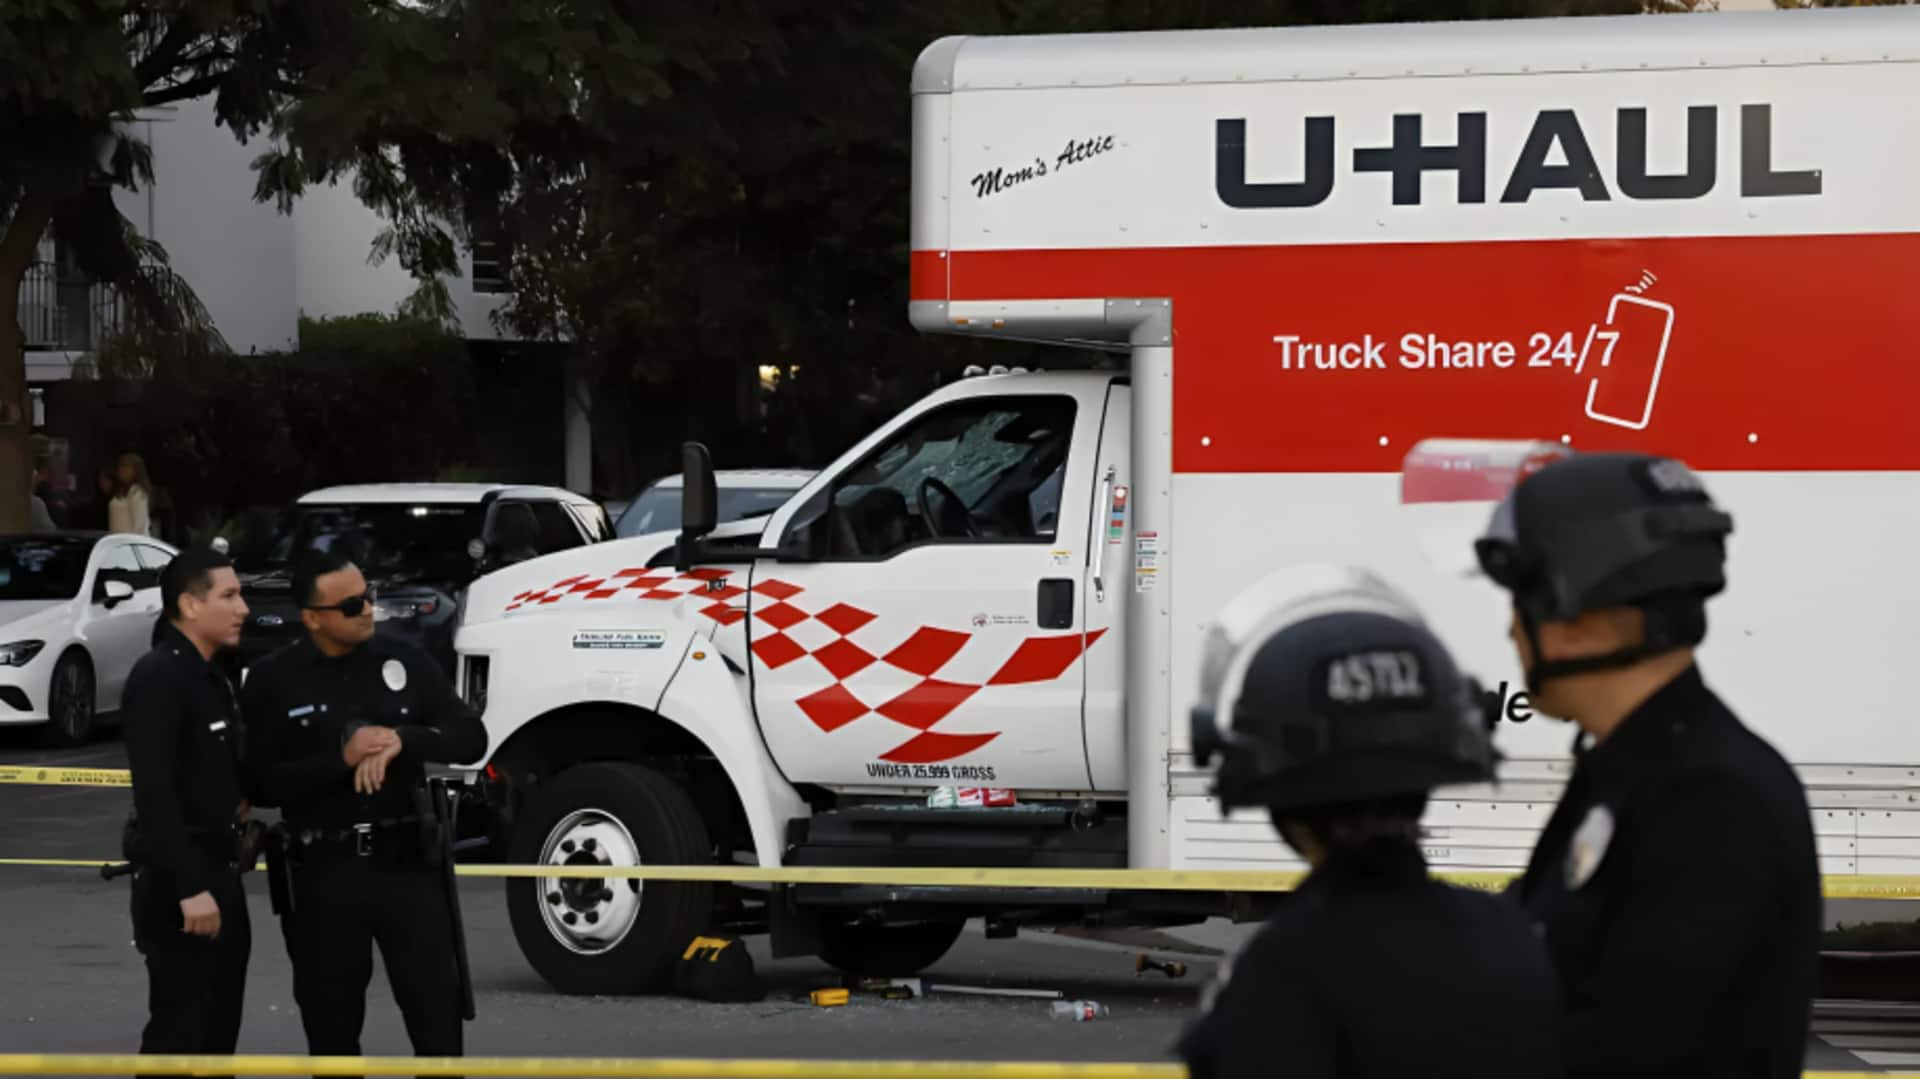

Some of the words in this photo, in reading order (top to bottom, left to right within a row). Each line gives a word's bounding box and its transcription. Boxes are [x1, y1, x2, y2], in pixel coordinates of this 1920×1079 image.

[970, 157, 1048, 199] Mom's
[1054, 135, 1115, 171] Attic
[1215, 104, 1823, 210] U-HAUL
[1273, 335, 1387, 370] Truck
[1399, 333, 1517, 368] Share
[1527, 323, 1621, 374] 24/7
